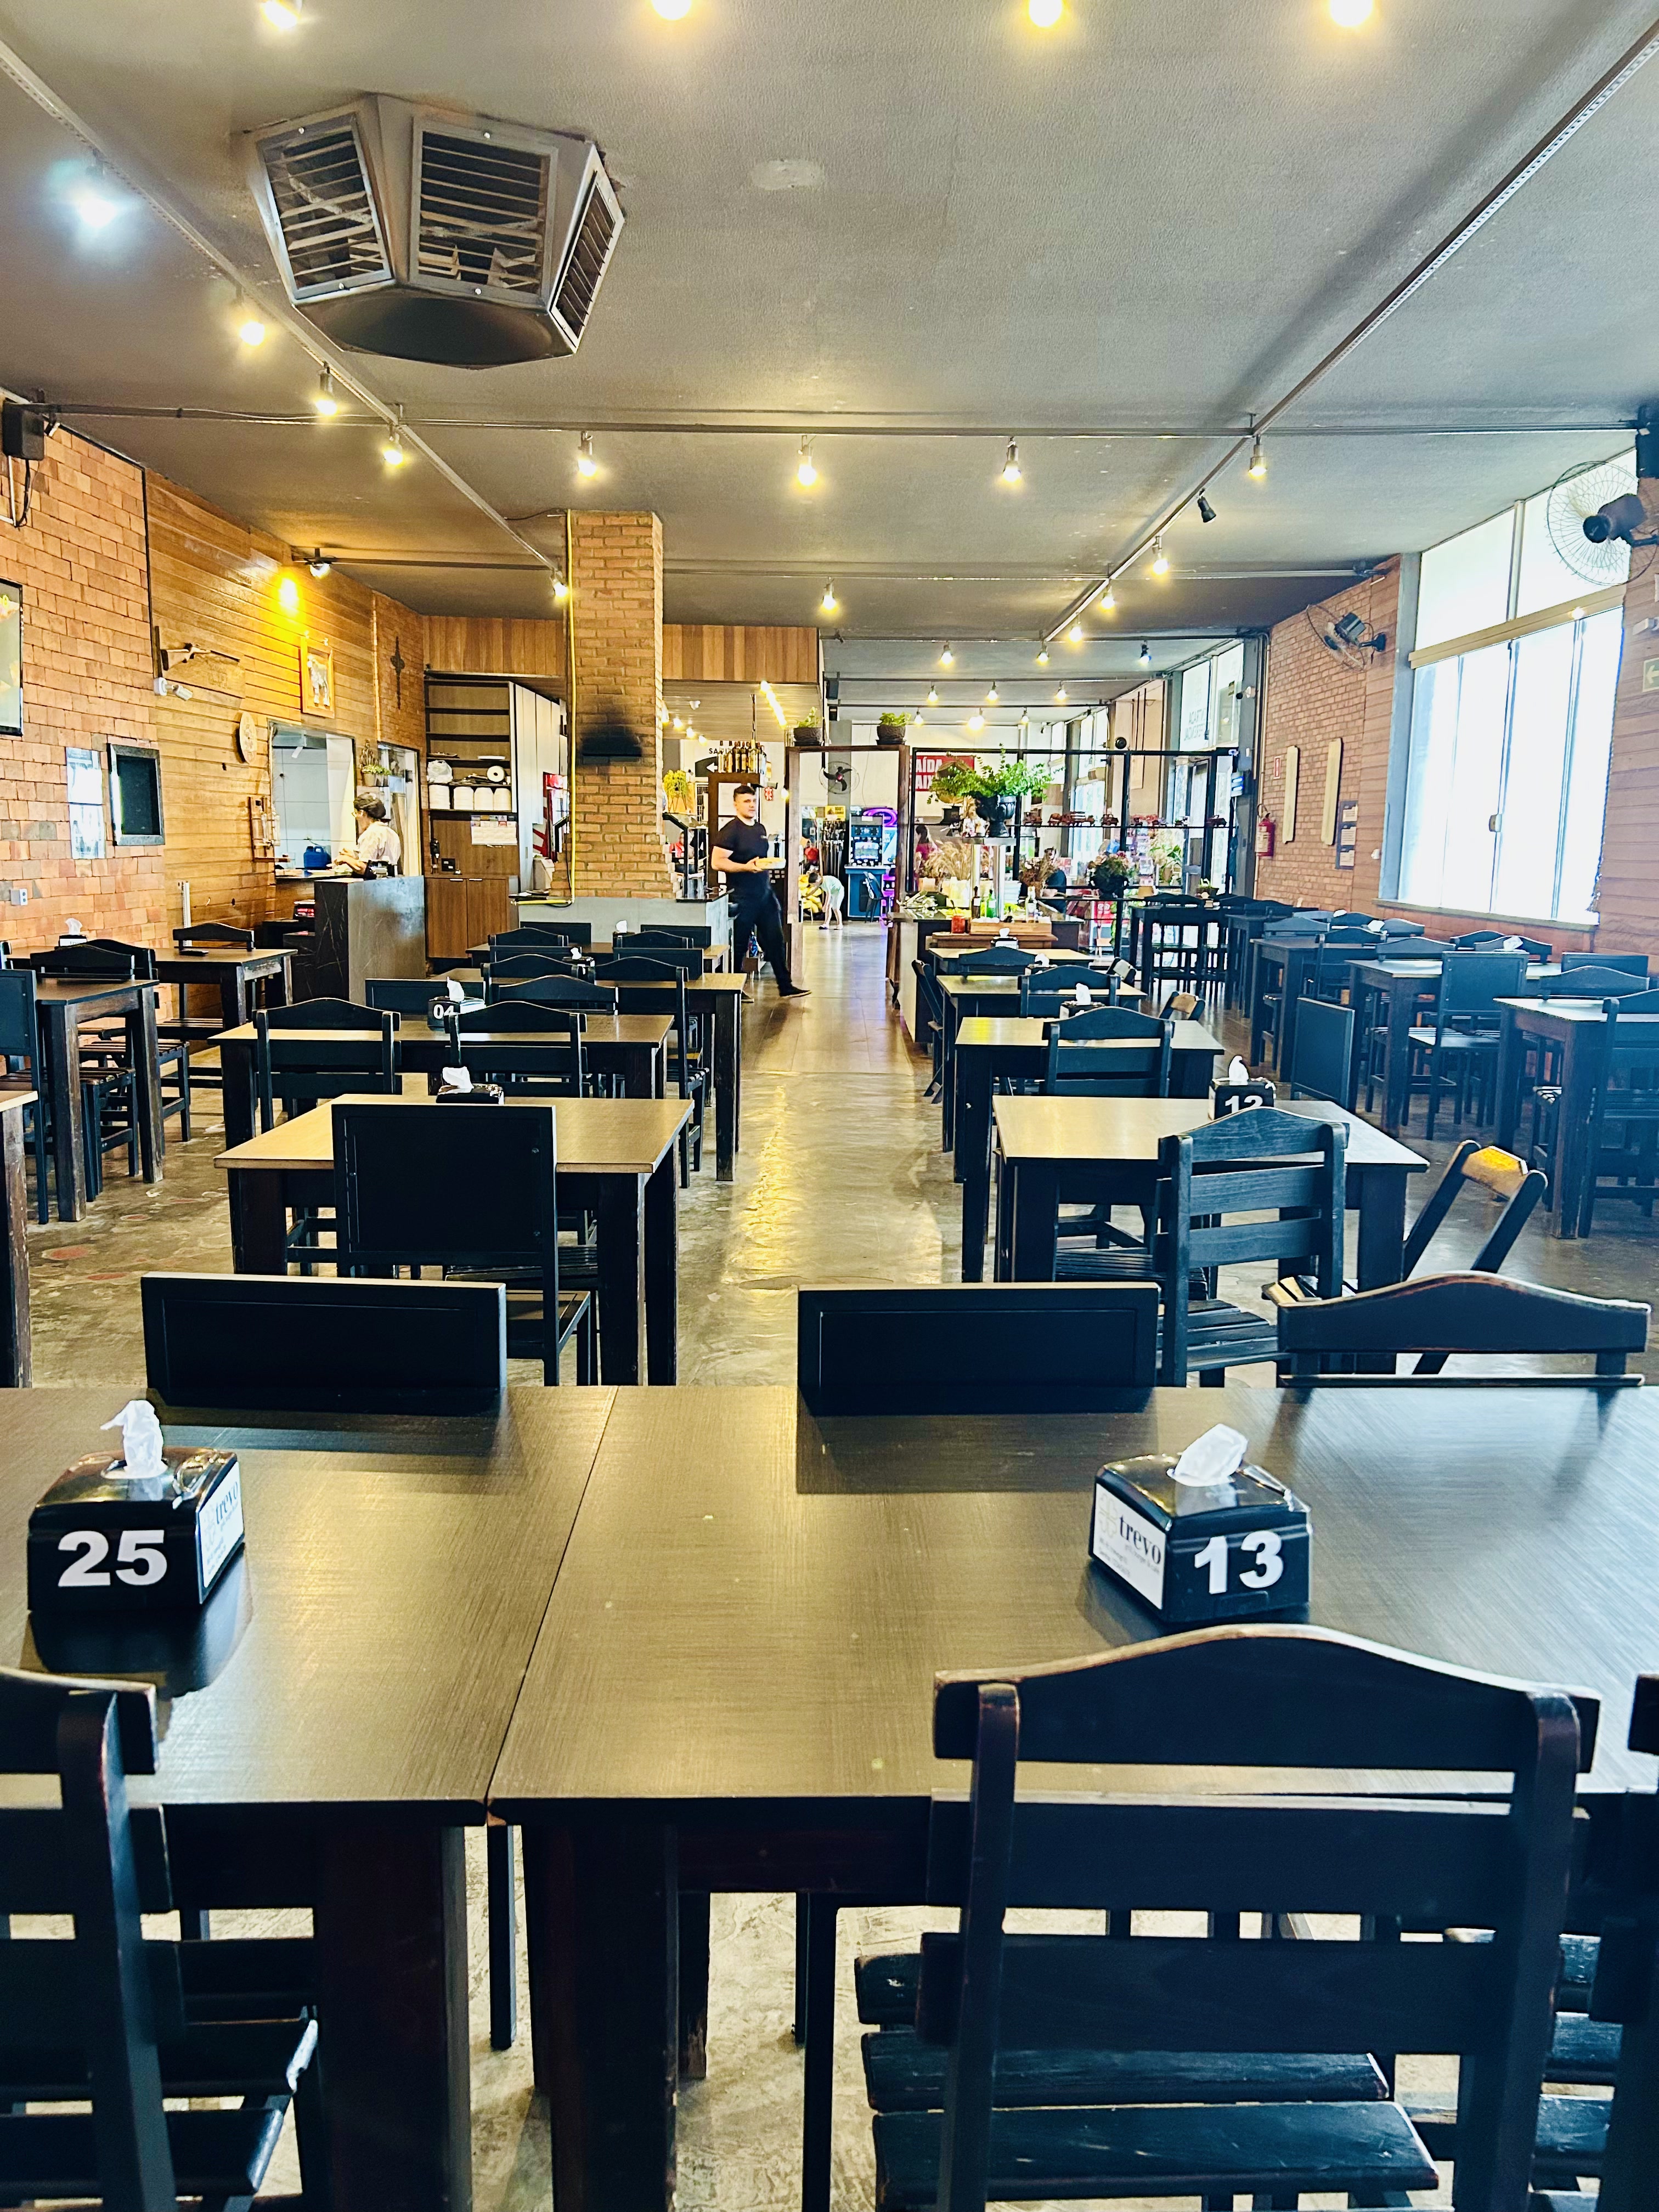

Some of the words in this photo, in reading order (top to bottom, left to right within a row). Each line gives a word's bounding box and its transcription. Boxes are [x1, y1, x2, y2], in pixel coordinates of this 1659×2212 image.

[910, 757, 943, 772] AÍDA
[433, 1004, 455, 1019] 04
[1225, 1096, 1263, 1113] 12
[216, 1481, 238, 1525] trevo
[58, 1530, 167, 1587] 25
[1120, 1515, 1161, 1565] trevo
[1194, 1531, 1283, 1594] 13
